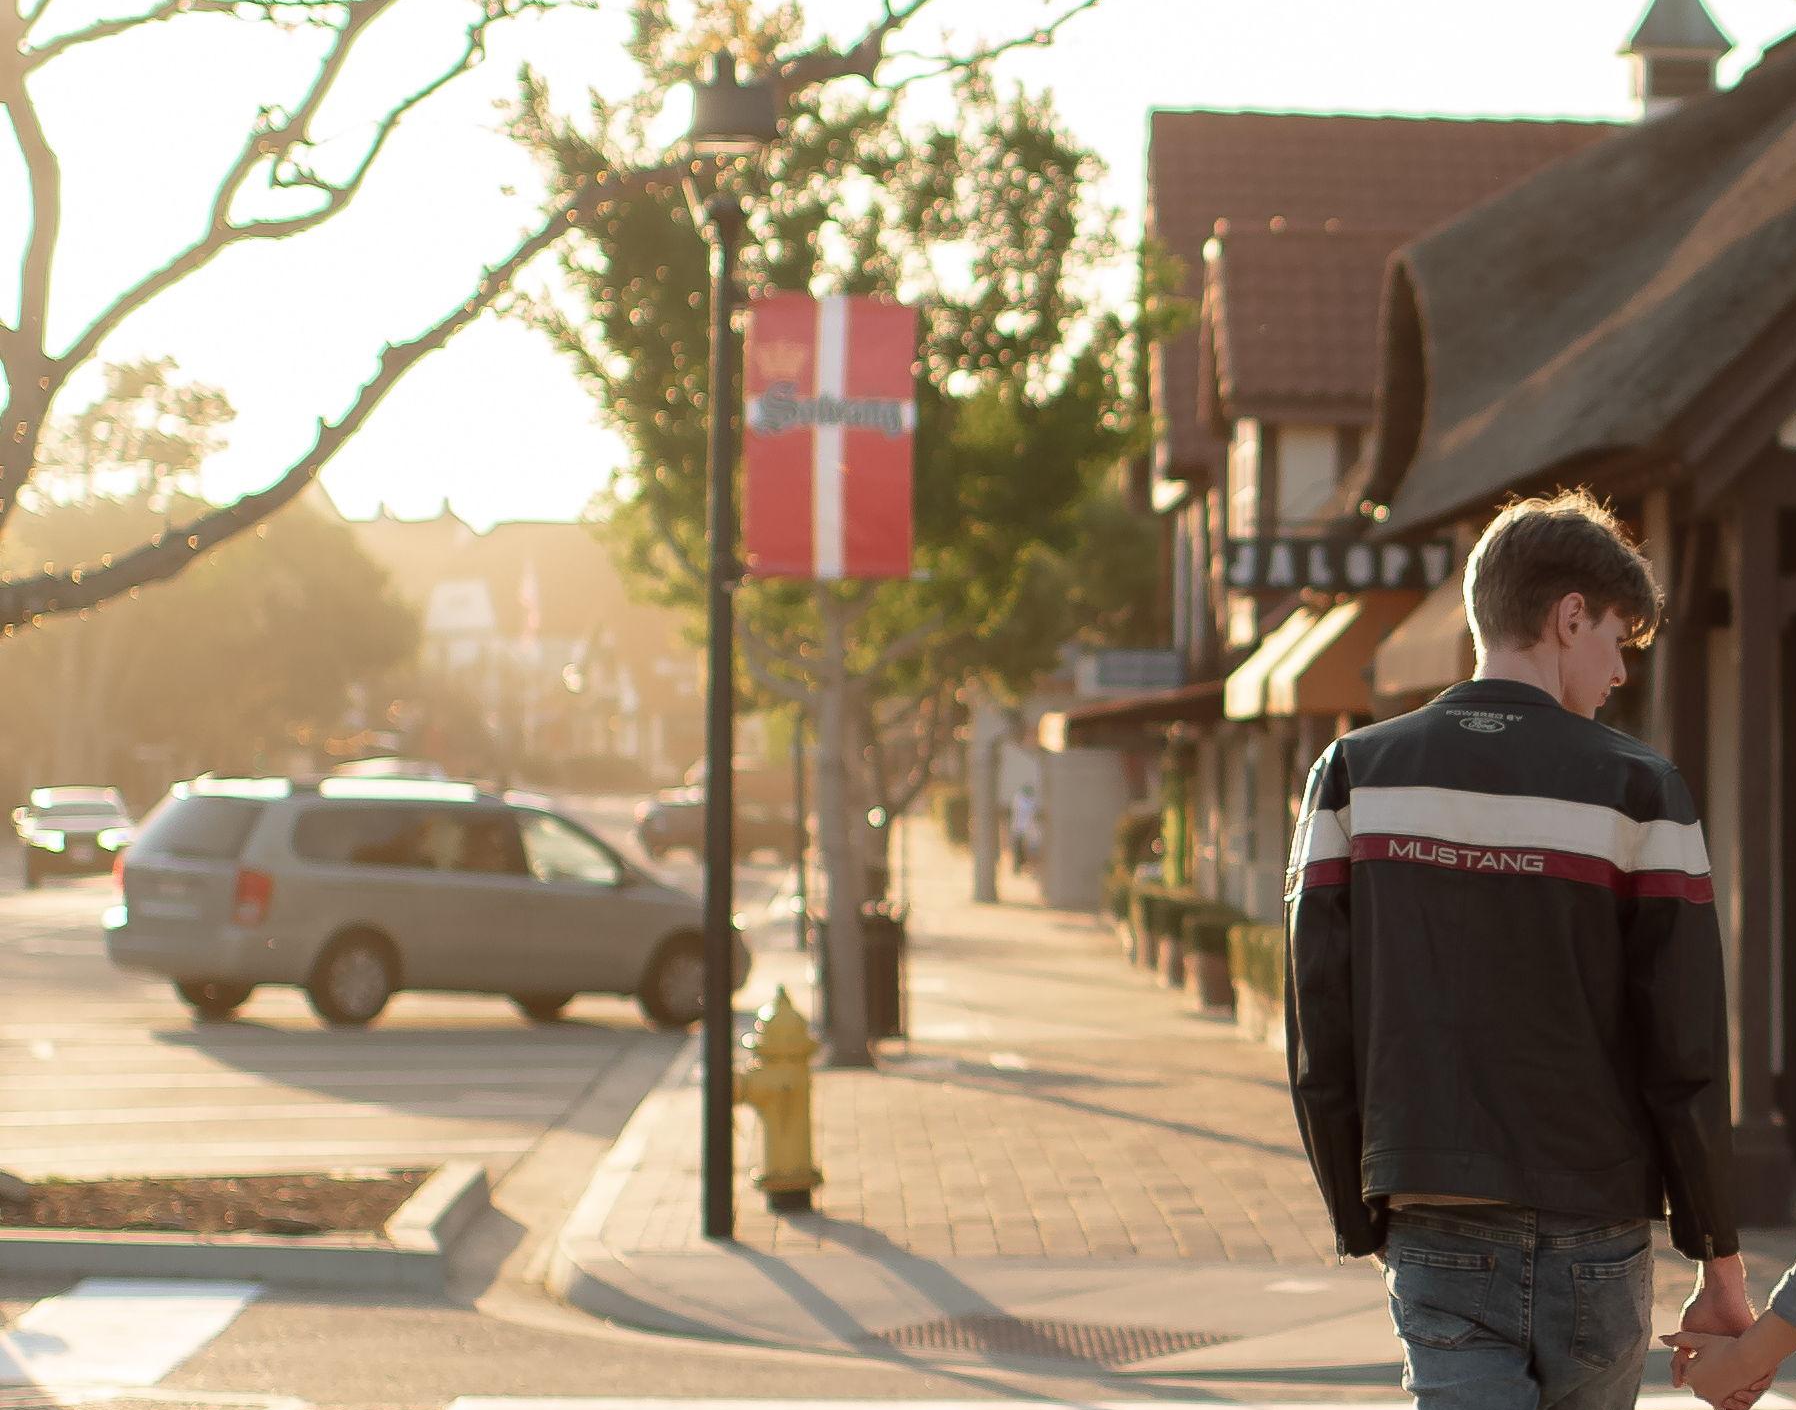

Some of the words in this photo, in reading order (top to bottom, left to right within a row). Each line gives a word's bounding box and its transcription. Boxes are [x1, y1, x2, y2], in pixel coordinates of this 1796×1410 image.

[1230, 542, 1449, 587] JALOPY
[1446, 710, 1504, 719] POWERED
[1506, 714, 1523, 722] BY
[1465, 716, 1500, 731] Ford
[1388, 839, 1544, 873] MUSTANG
